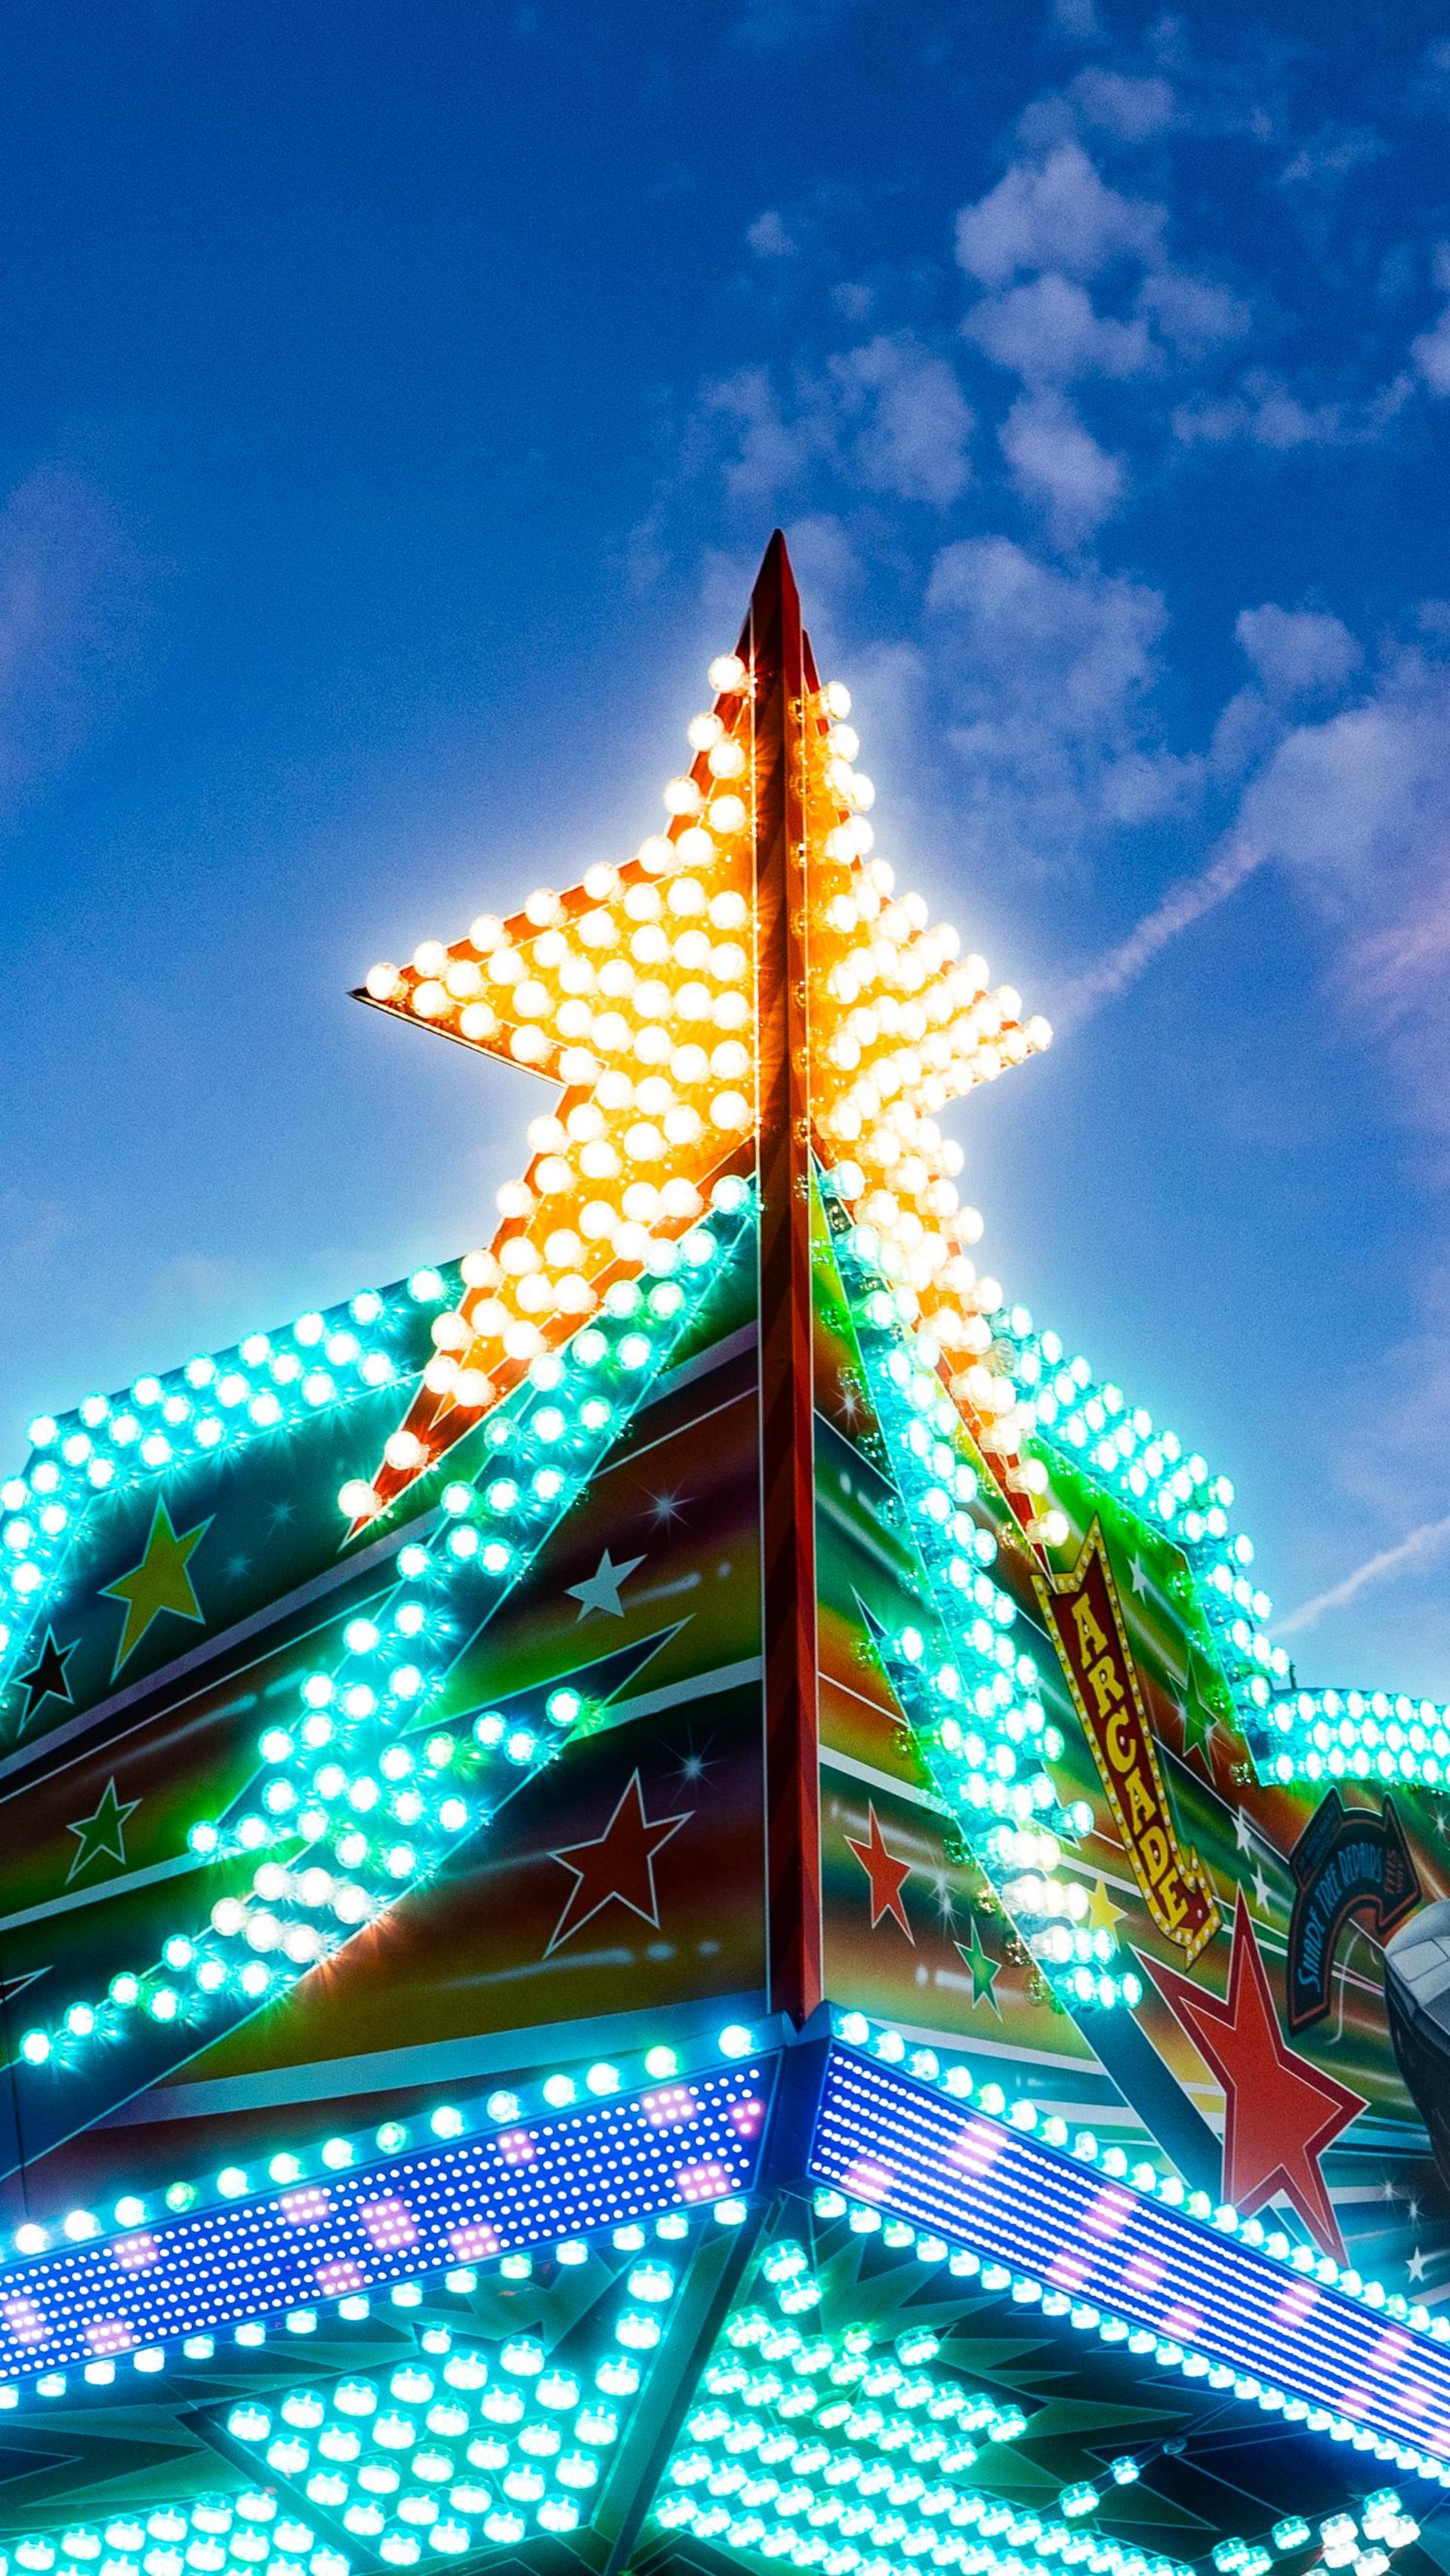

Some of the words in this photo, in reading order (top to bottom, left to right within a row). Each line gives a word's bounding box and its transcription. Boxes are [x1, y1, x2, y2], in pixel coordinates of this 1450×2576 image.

[1071, 1592, 1189, 1930] ARCADE
[1298, 1906, 1325, 1993] SHADE
[1315, 1862, 1342, 1918] TREE
